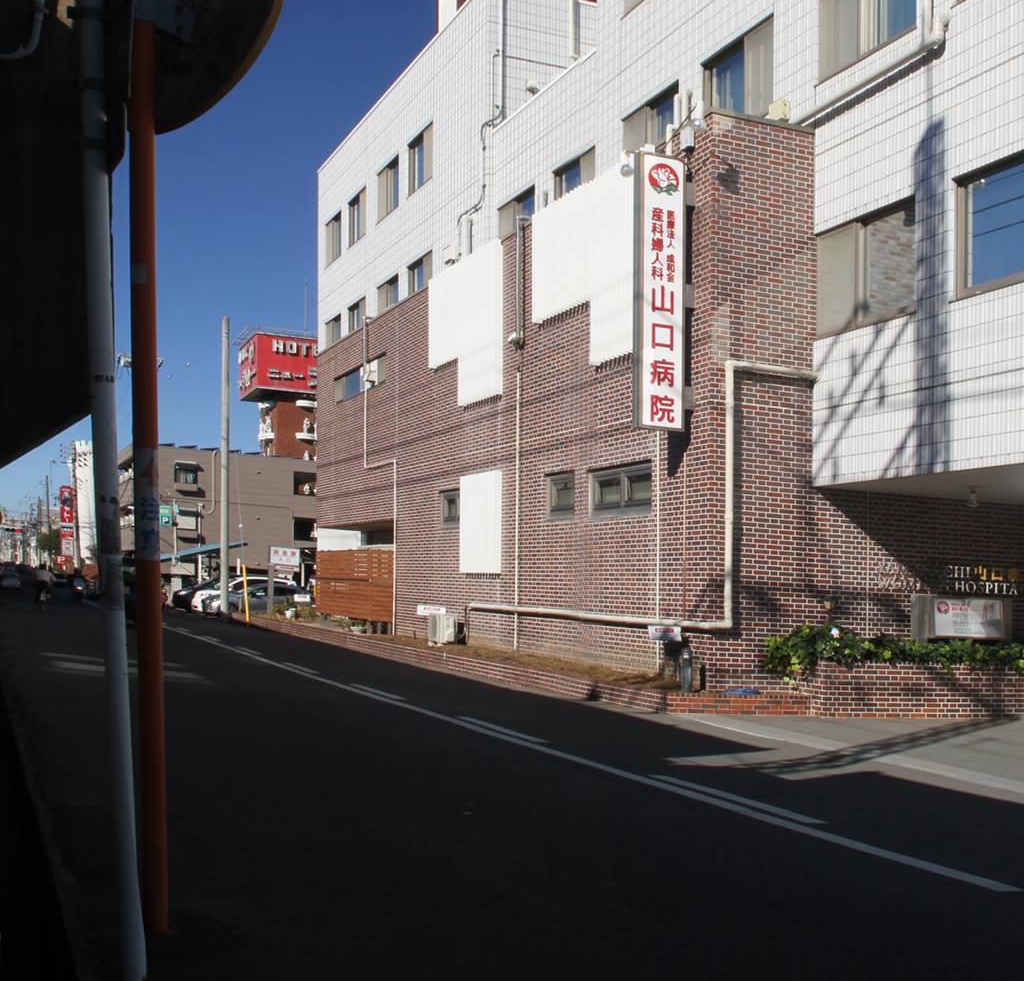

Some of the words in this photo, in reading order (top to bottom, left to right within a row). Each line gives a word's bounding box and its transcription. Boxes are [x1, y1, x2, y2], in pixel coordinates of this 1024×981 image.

[651, 207, 664, 281] 産科婦人科
[650, 285, 675, 424] 山口病院
